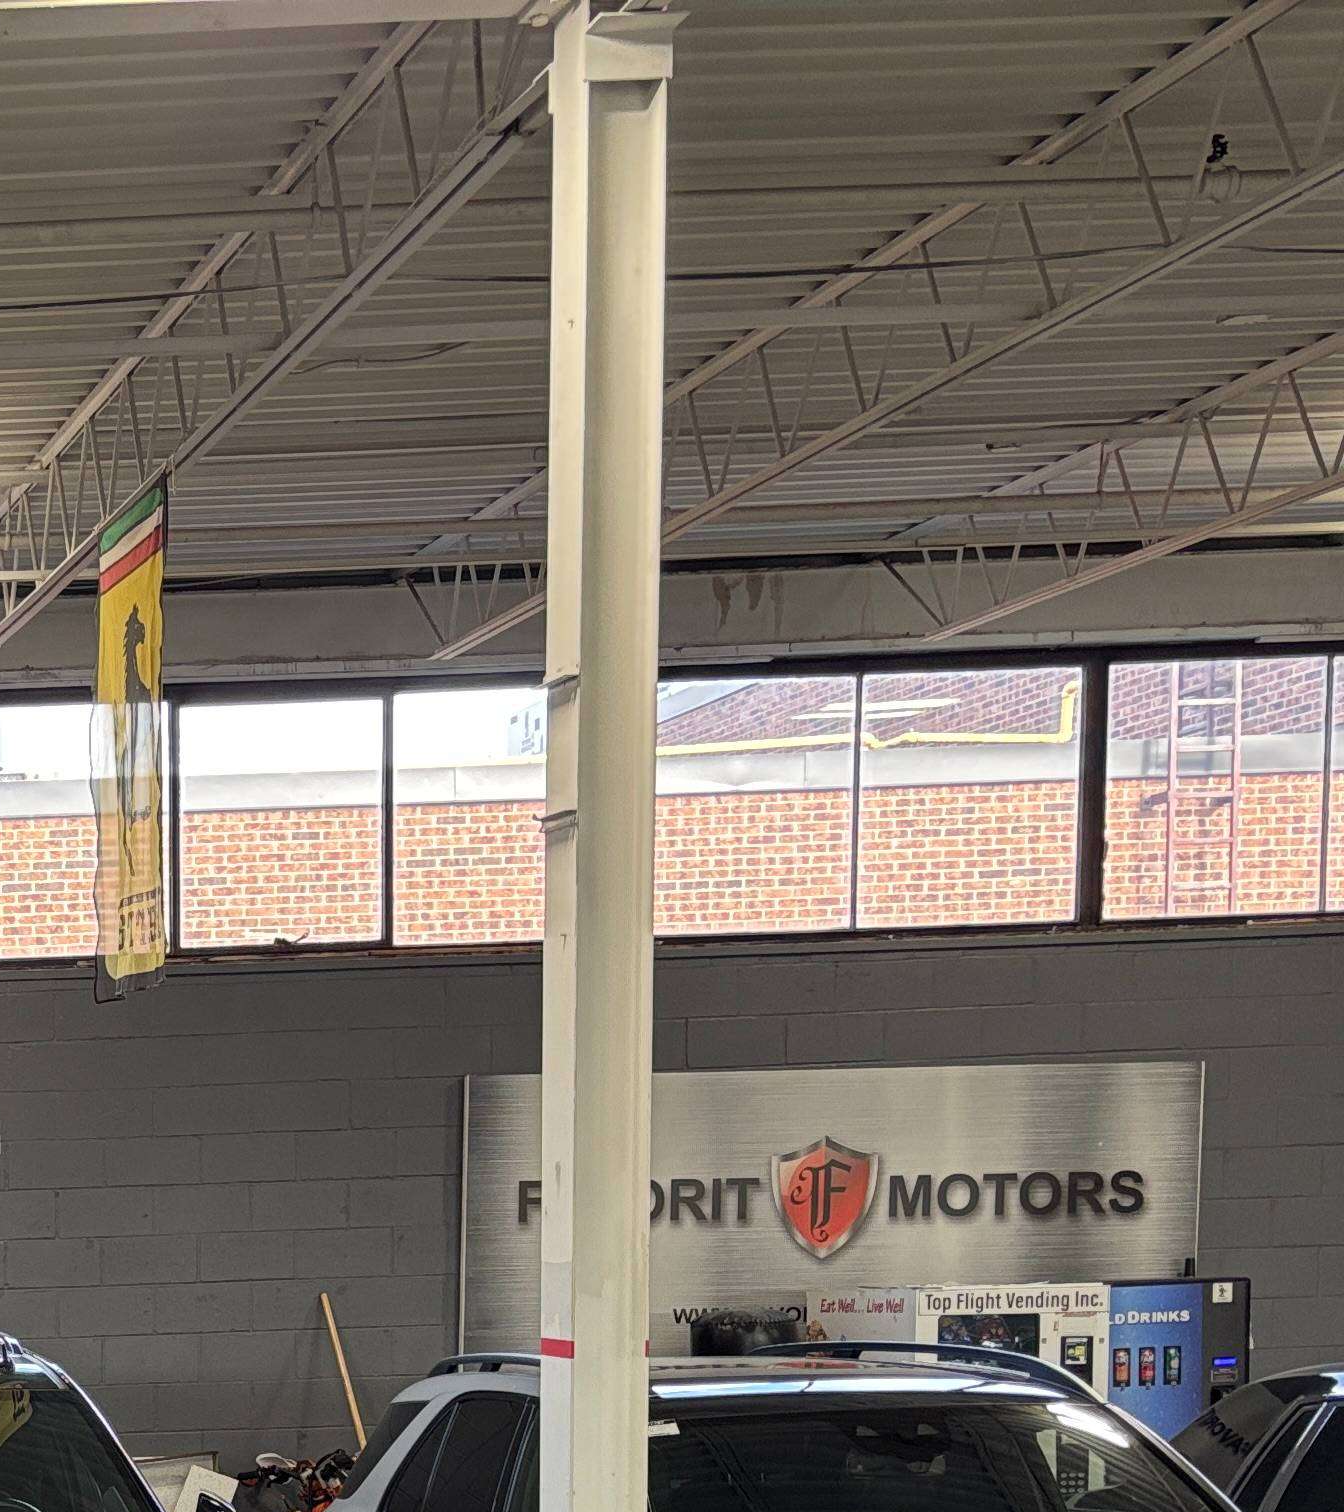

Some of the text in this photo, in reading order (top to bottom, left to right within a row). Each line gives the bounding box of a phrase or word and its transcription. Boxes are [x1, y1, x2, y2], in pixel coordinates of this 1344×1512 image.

[518, 1177, 760, 1222] FRIT
[888, 1170, 1144, 1218] MOTORS
[820, 1298, 836, 1313] Eat
[867, 1298, 904, 1313] Live Well
[926, 1291, 1103, 1312] Top Flight Vending Inc.
[1127, 1310, 1190, 1324] DRINKS
